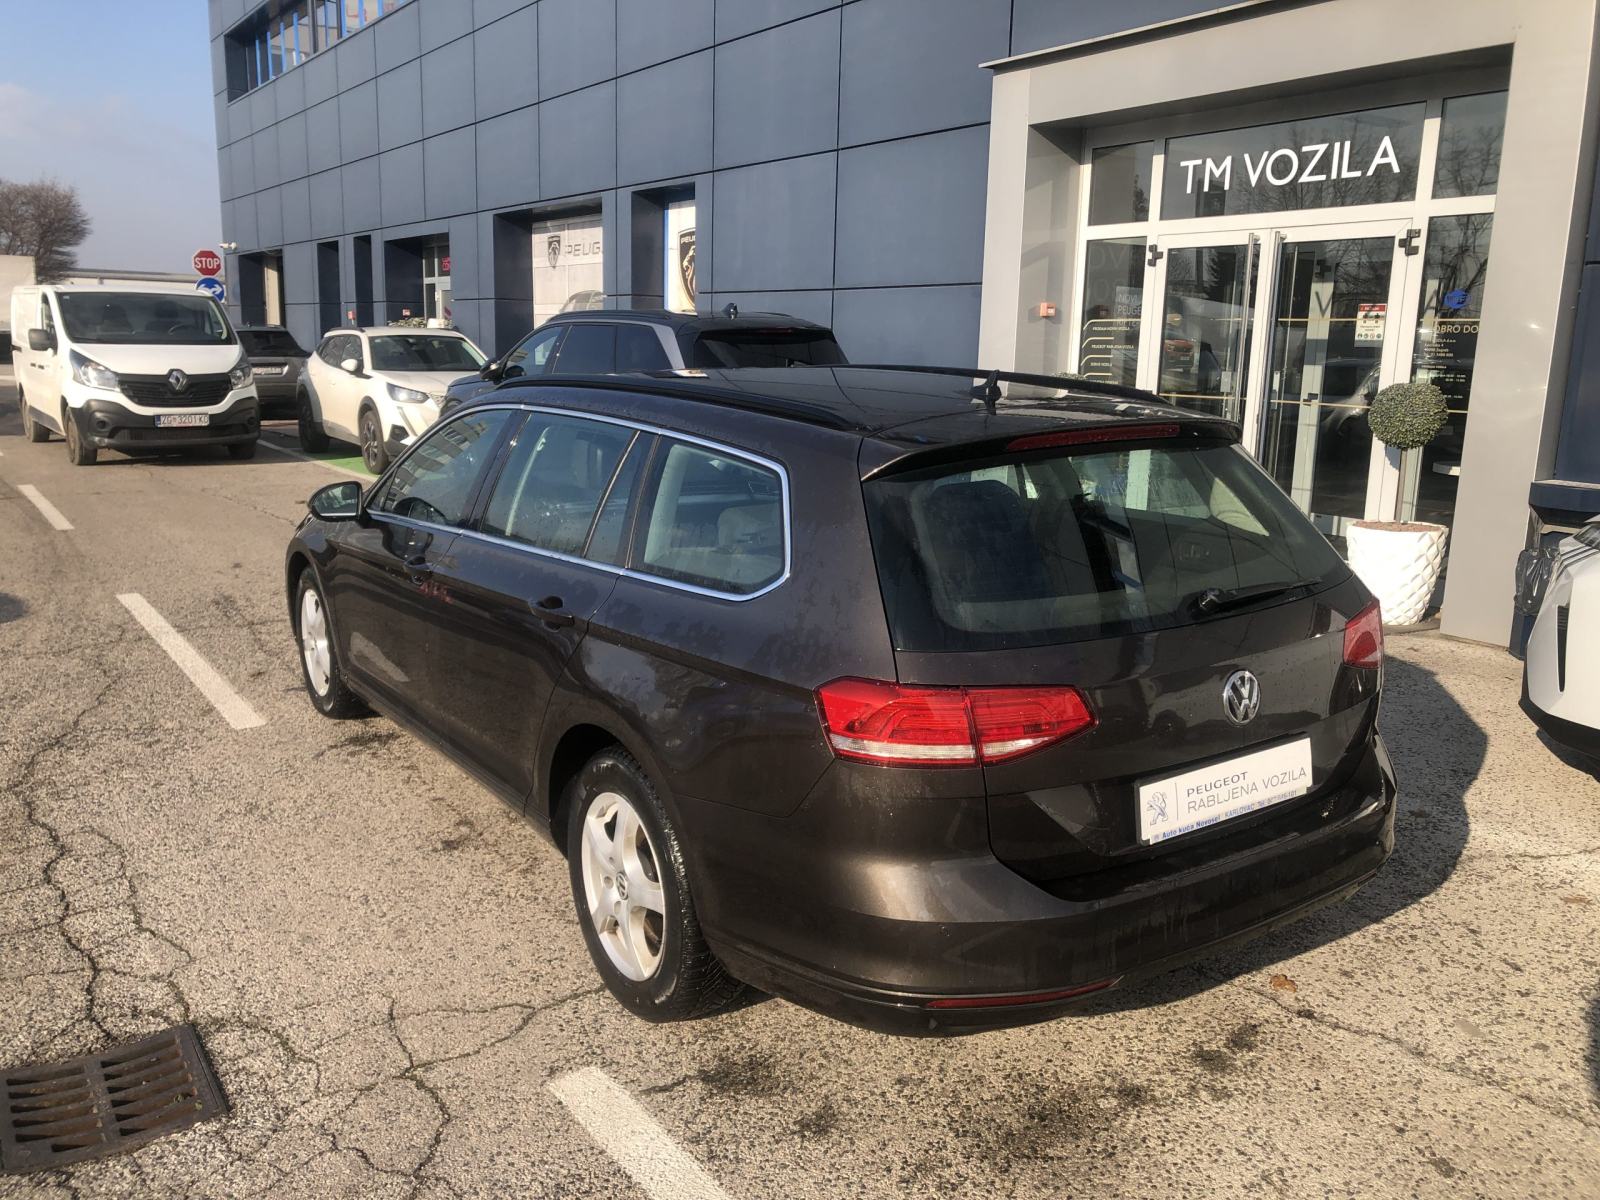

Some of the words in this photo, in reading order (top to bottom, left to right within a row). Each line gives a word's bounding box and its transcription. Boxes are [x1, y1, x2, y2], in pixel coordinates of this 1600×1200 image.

[1179, 155, 1233, 194] TM
[1243, 135, 1401, 188] VOZILA
[680, 235, 696, 244] PEU
[565, 241, 601, 257] PEUG
[194, 257, 220, 269] STOP
[1117, 305, 1142, 315] PEUGE
[1463, 325, 1480, 334] DO
[161, 415, 172, 425] ZG
[1187, 772, 1248, 797] PEUGEOT
[1187, 782, 1259, 814] RABLJENA
[1262, 767, 1307, 789] VOZILA
[1162, 829, 1177, 840] Auto
[1195, 814, 1221, 831] Novosel
[1224, 803, 1255, 819] KARLOVAC
